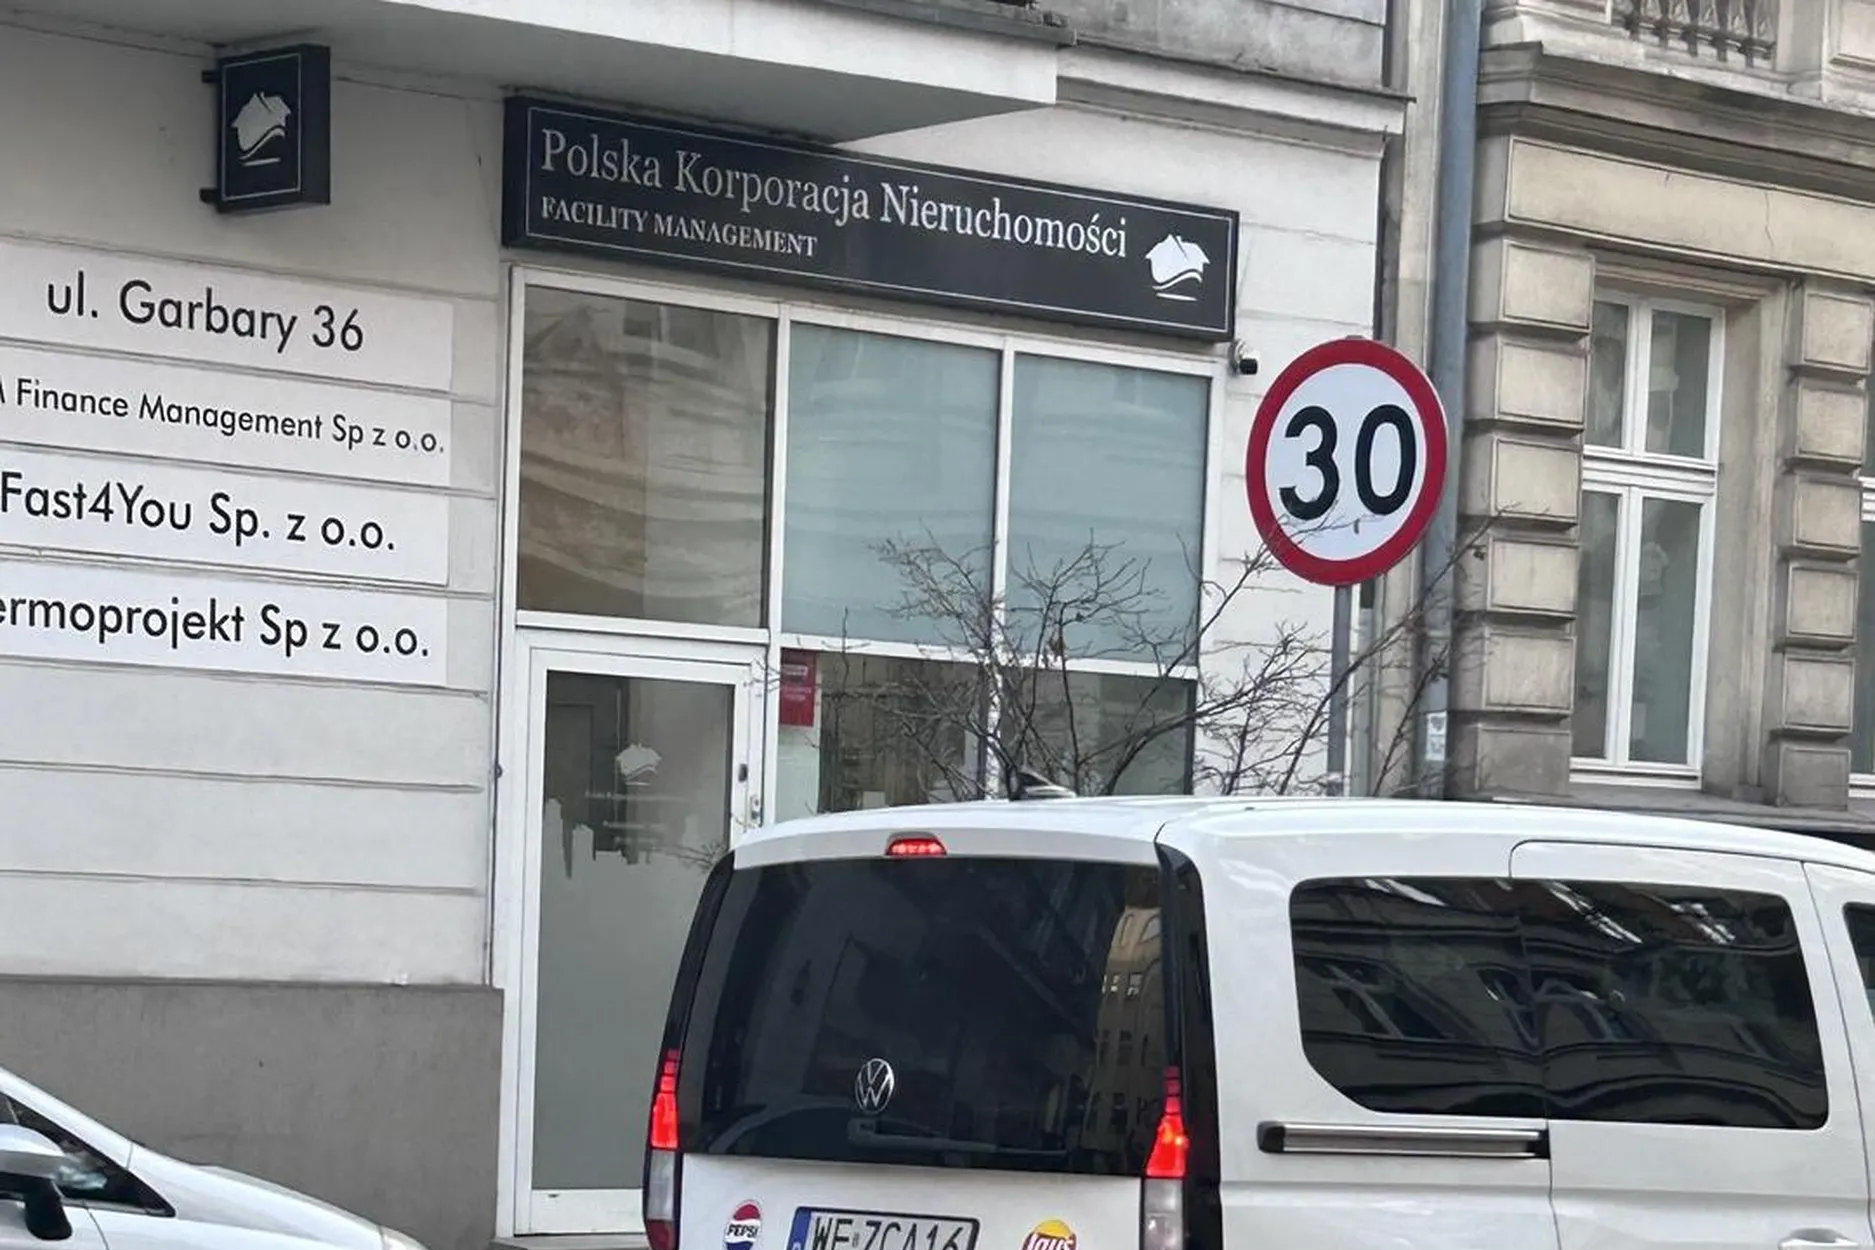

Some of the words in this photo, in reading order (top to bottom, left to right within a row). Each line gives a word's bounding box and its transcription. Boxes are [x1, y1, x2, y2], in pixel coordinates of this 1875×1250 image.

[541, 128, 662, 189] Polska
[674, 150, 869, 226] Korporacja
[880, 182, 1126, 258] Nieruchomości
[541, 197, 648, 233] FACILITY
[654, 213, 818, 257] MANAGEMENT
[48, 270, 98, 318] ul.
[119, 279, 297, 353] Garbary
[312, 305, 364, 351] 36
[17, 378, 129, 417] Finance
[138, 393, 322, 439] Management
[332, 414, 364, 450] Sp
[372, 427, 387, 447] z
[395, 430, 444, 453] o.o.
[1279, 403, 1417, 521] 30
[1, 471, 192, 530] Fast4You
[209, 492, 270, 547] Sp.
[286, 513, 306, 541] z
[320, 517, 395, 550] o.o.
[0, 596, 245, 649] rmoprojekt
[260, 604, 307, 657] Sp
[322, 622, 341, 650] z
[355, 625, 429, 657] o.o.
[727, 1223, 759, 1239] PEPSI
